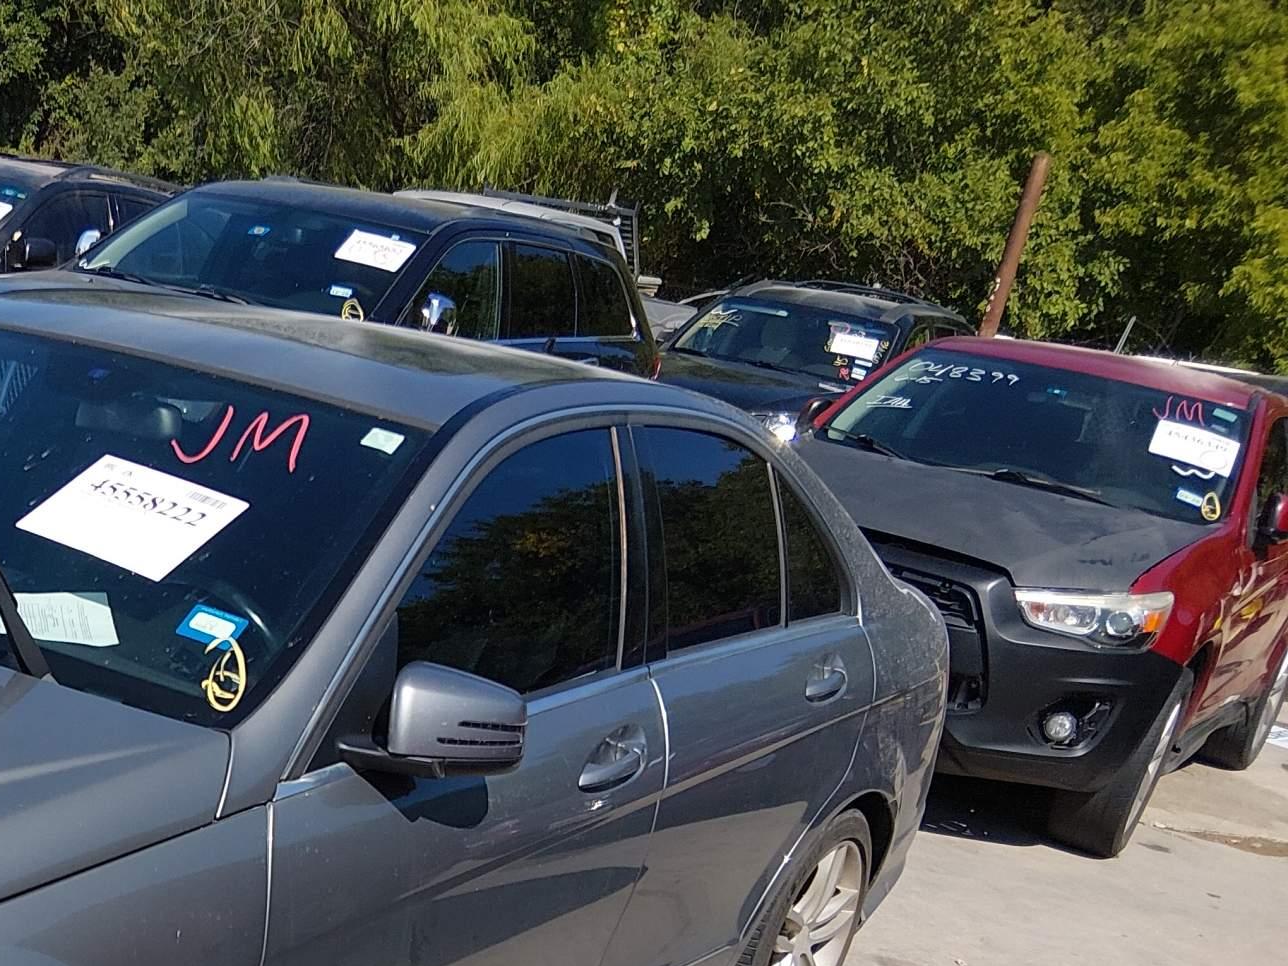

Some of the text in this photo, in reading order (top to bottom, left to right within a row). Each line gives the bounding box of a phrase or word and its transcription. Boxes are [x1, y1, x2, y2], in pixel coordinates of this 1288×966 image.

[1152, 395, 1205, 427] JM
[171, 404, 310, 474] JM
[91, 479, 207, 527] 45558222
